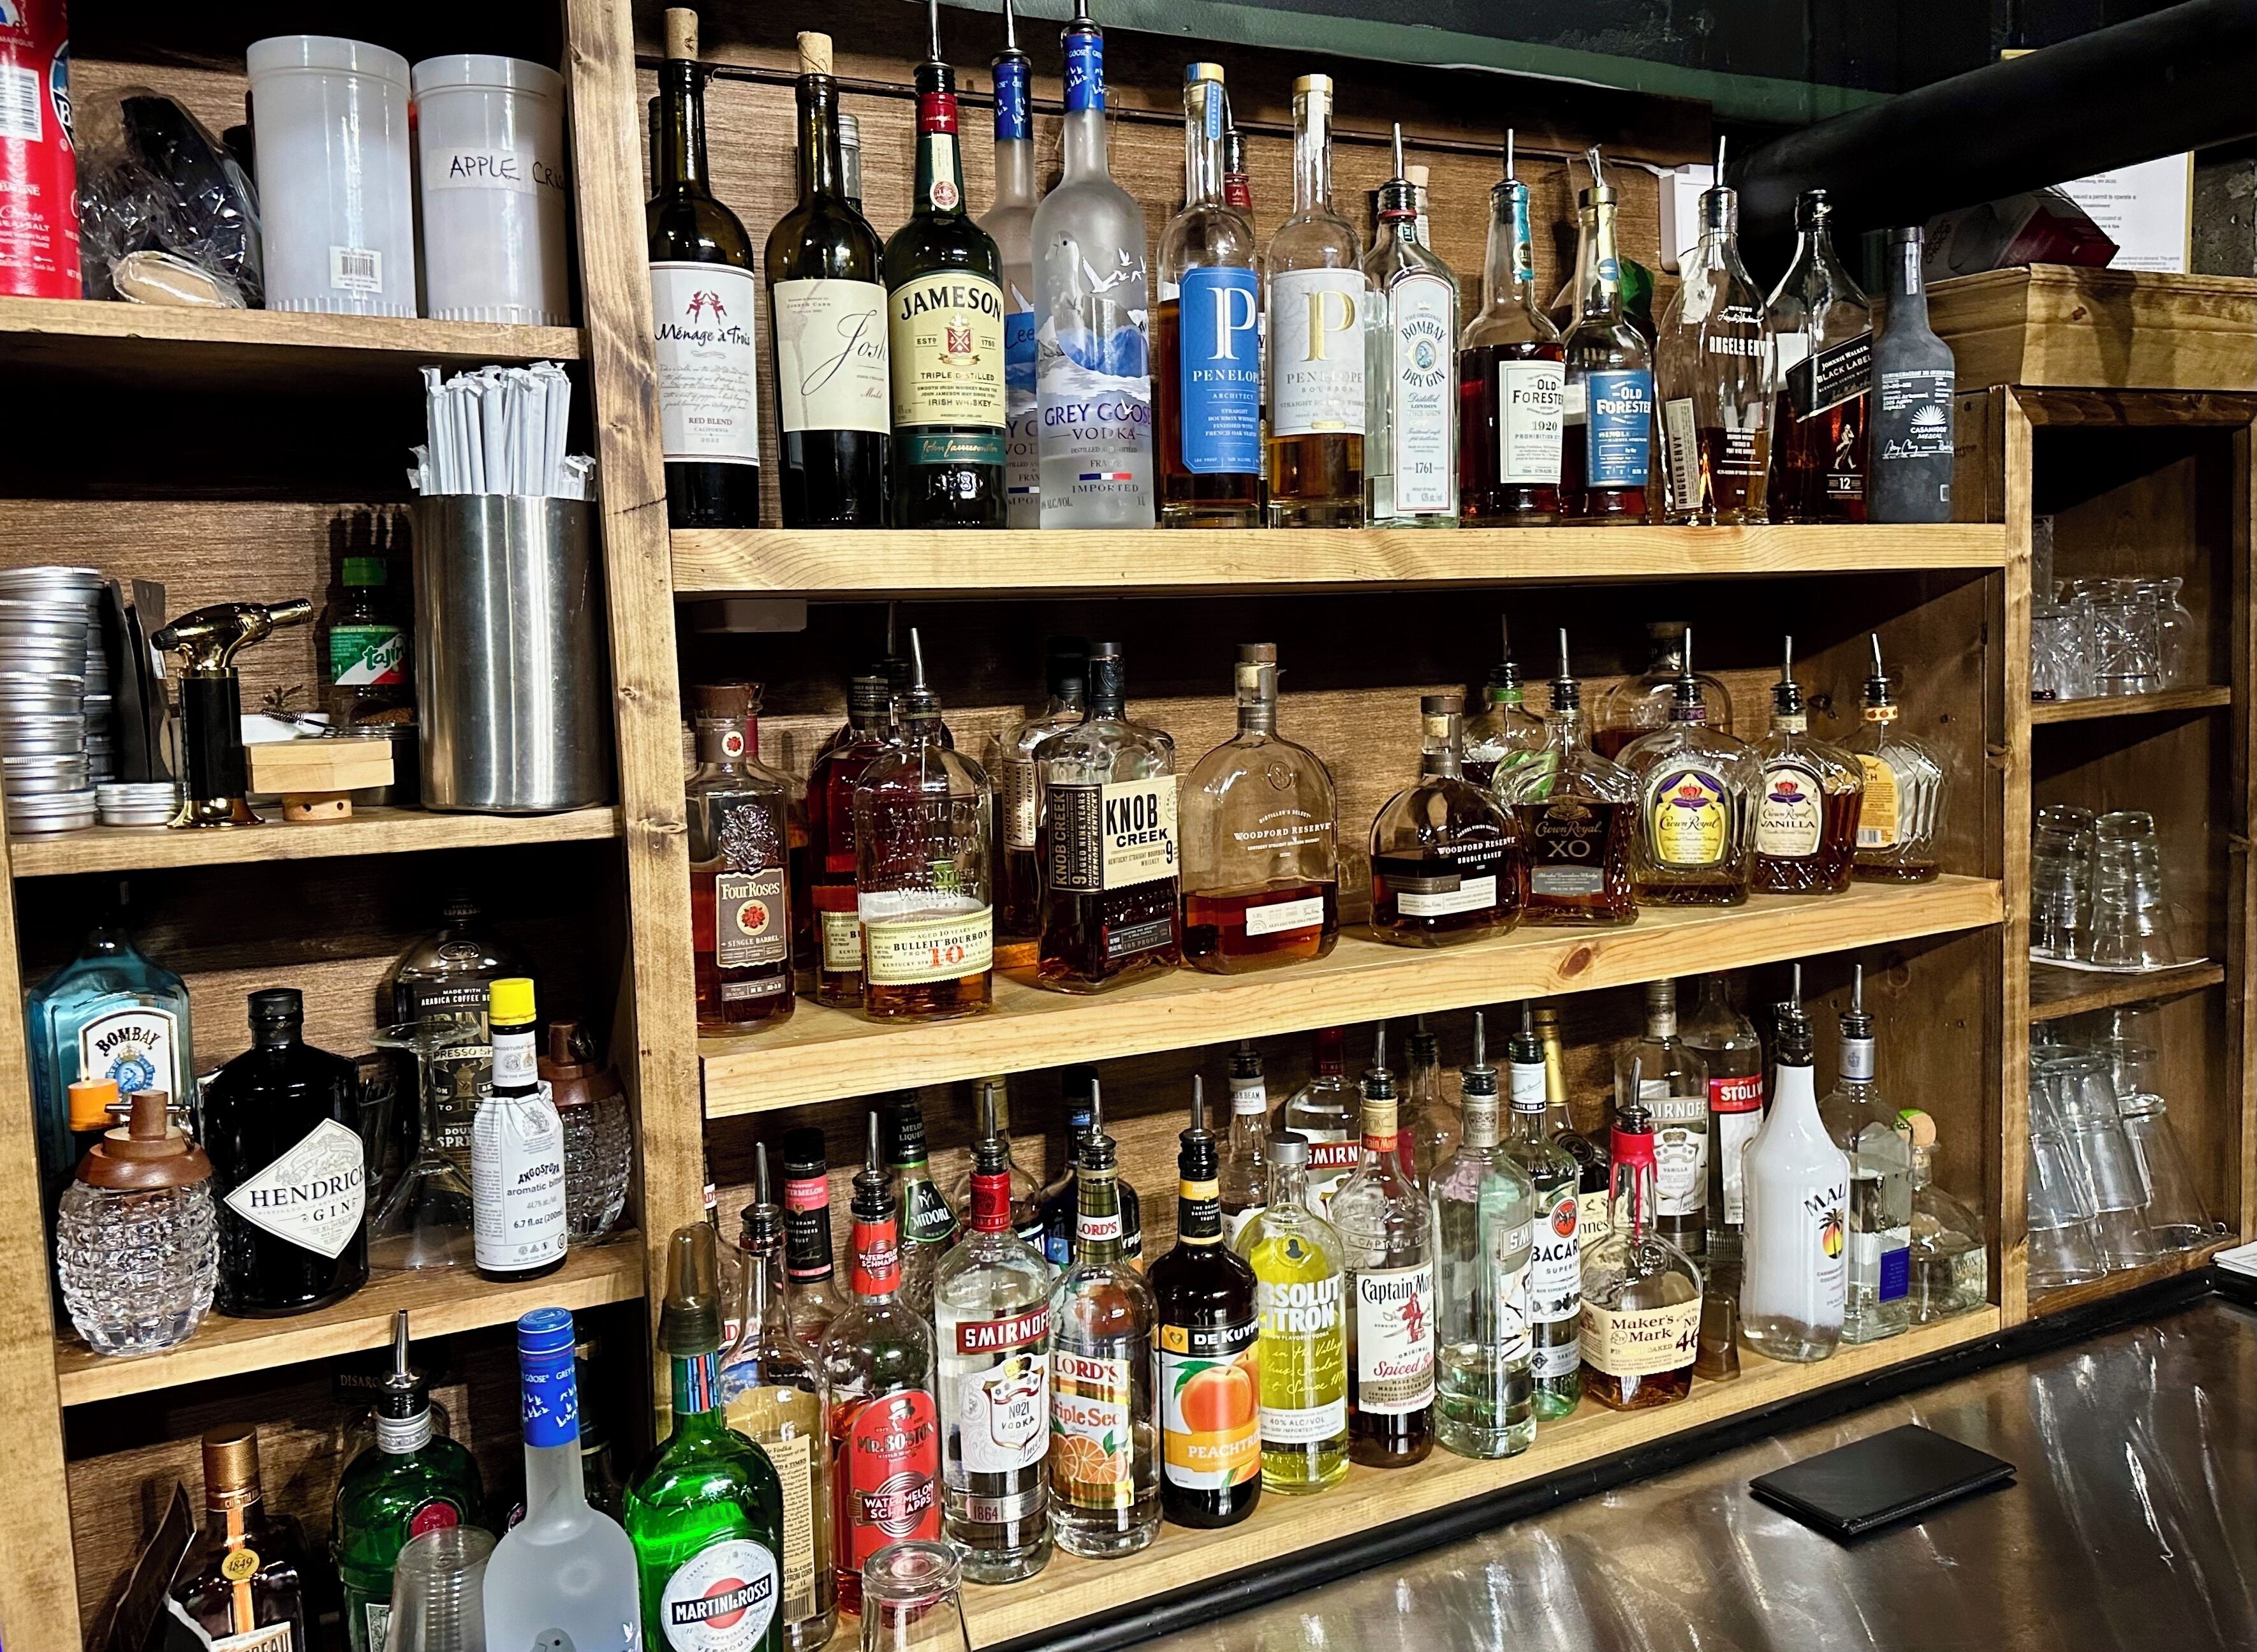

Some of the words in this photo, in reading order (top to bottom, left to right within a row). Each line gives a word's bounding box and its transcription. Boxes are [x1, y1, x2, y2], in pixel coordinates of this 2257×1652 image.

[450, 156, 520, 181] APPLE
[901, 286, 1001, 322] JAMESON
[1207, 288, 1256, 360] P
[1416, 313, 1442, 323] ORIGINAL
[654, 323, 714, 346] Ménage
[717, 328, 726, 342] à
[728, 325, 750, 345] Trois
[1300, 291, 1355, 362] P
[1401, 321, 1446, 344] BOMBAY
[802, 310, 887, 395] Josh
[1821, 355, 1846, 371] JOHNNIE
[1844, 345, 1870, 360] WALKER
[1816, 365, 1845, 383] BLACK
[1846, 353, 1872, 371] LABEL
[1286, 371, 1363, 385] PENELOPE
[1402, 370, 1425, 387] DRY
[1427, 369, 1446, 387] GIN
[1537, 379, 1556, 391] OLD
[1408, 392, 1440, 404] Distilled
[1621, 387, 1642, 400] OLD
[955, 399, 991, 408] WHISKEY
[1045, 404, 1092, 426] GREY
[1098, 401, 1151, 422] GOOSE
[1072, 427, 1136, 440] VODKA
[1531, 421, 1557, 431] 1920
[1673, 436, 1683, 464] ENVY
[1415, 462, 1433, 474] 1761
[1072, 484, 1138, 494] IMPORTED
[1839, 477, 1851, 490] 12
[1054, 792, 1066, 841] CREEK
[1106, 793, 1158, 836] KNOB
[1259, 809, 1291, 824] DISTILLER'S
[1292, 809, 1310, 818] SELECT
[1763, 808, 1785, 819] Crown
[1782, 808, 1810, 820] Royal
[1535, 821, 1567, 837] Crown
[1561, 821, 1601, 837] Royal
[1660, 816, 1689, 830] Crown
[1684, 815, 1721, 830] Royal
[1116, 829, 1168, 848] CREEK
[1233, 829, 1288, 841] WOODFORD
[1291, 822, 1331, 835] RESERVE
[1457, 827, 1471, 838] BARREL
[1166, 840, 1173, 864] 9
[1437, 842, 1483, 855] WOODFORD
[1485, 836, 1516, 848] RESERVE
[1548, 840, 1591, 857] XO
[1055, 844, 1068, 885] KNOB
[1108, 855, 1127, 866] KENTUCKY
[1129, 852, 1147, 862] STRAIGHT
[1148, 849, 1165, 859] BOURBON
[1141, 858, 1159, 866] WHISKEY
[1458, 855, 1481, 864] DOUBLE
[1483, 851, 1502, 860] OAKED
[1072, 876, 1087, 885] 9
[898, 882, 980, 901] WHISKEY
[727, 937, 753, 948] SINGLE
[755, 934, 779, 945] BARREL
[893, 940, 939, 952] BULLEIT
[945, 930, 988, 946] BOURBON
[1138, 936, 1158, 946] PROOF
[929, 945, 965, 968] 10
[422, 994, 450, 1006] ARABICA
[453, 994, 479, 1003] COFFEE
[95, 1027, 161, 1056] BOMBAY
[518, 1162, 559, 1184] ANGOSTURA
[507, 1183, 546, 1196] aromatic
[314, 1200, 349, 1221] GIN
[911, 1207, 951, 1230] MIDORI
[514, 1220, 526, 1228] 6.7
[1362, 1276, 1417, 1304] Captain
[966, 1310, 1050, 1348] SMIRNOFF
[1611, 1315, 1673, 1329] Maker's
[1194, 1333, 1218, 1346] DE
[1312, 1331, 1329, 1339] VODKA
[1629, 1328, 1672, 1343] Mark
[1675, 1326, 1700, 1352] 46
[1398, 1347, 1428, 1359] ORIGINAL
[1298, 1359, 1342, 1376] Sweden
[1374, 1357, 1420, 1378] Spiced
[525, 1375, 546, 1383] GOOSE
[556, 1369, 571, 1380] GREY
[1287, 1378, 1327, 1394] Since
[1378, 1382, 1421, 1391] MADAGASCAR
[1002, 1415, 1035, 1430] VODKA
[1088, 1407, 1121, 1427] Sec
[1290, 1417, 1325, 1426] ALC/VOL
[885, 1420, 934, 1452] BOSTON
[789, 1457, 807, 1468] TIMES
[865, 1480, 934, 1508] WATERMELON
[871, 1494, 931, 1519] SCHNAPPS
[974, 1506, 998, 1521] 1864
[228, 1557, 253, 1572] 1849
[786, 1572, 800, 1582] FROM
